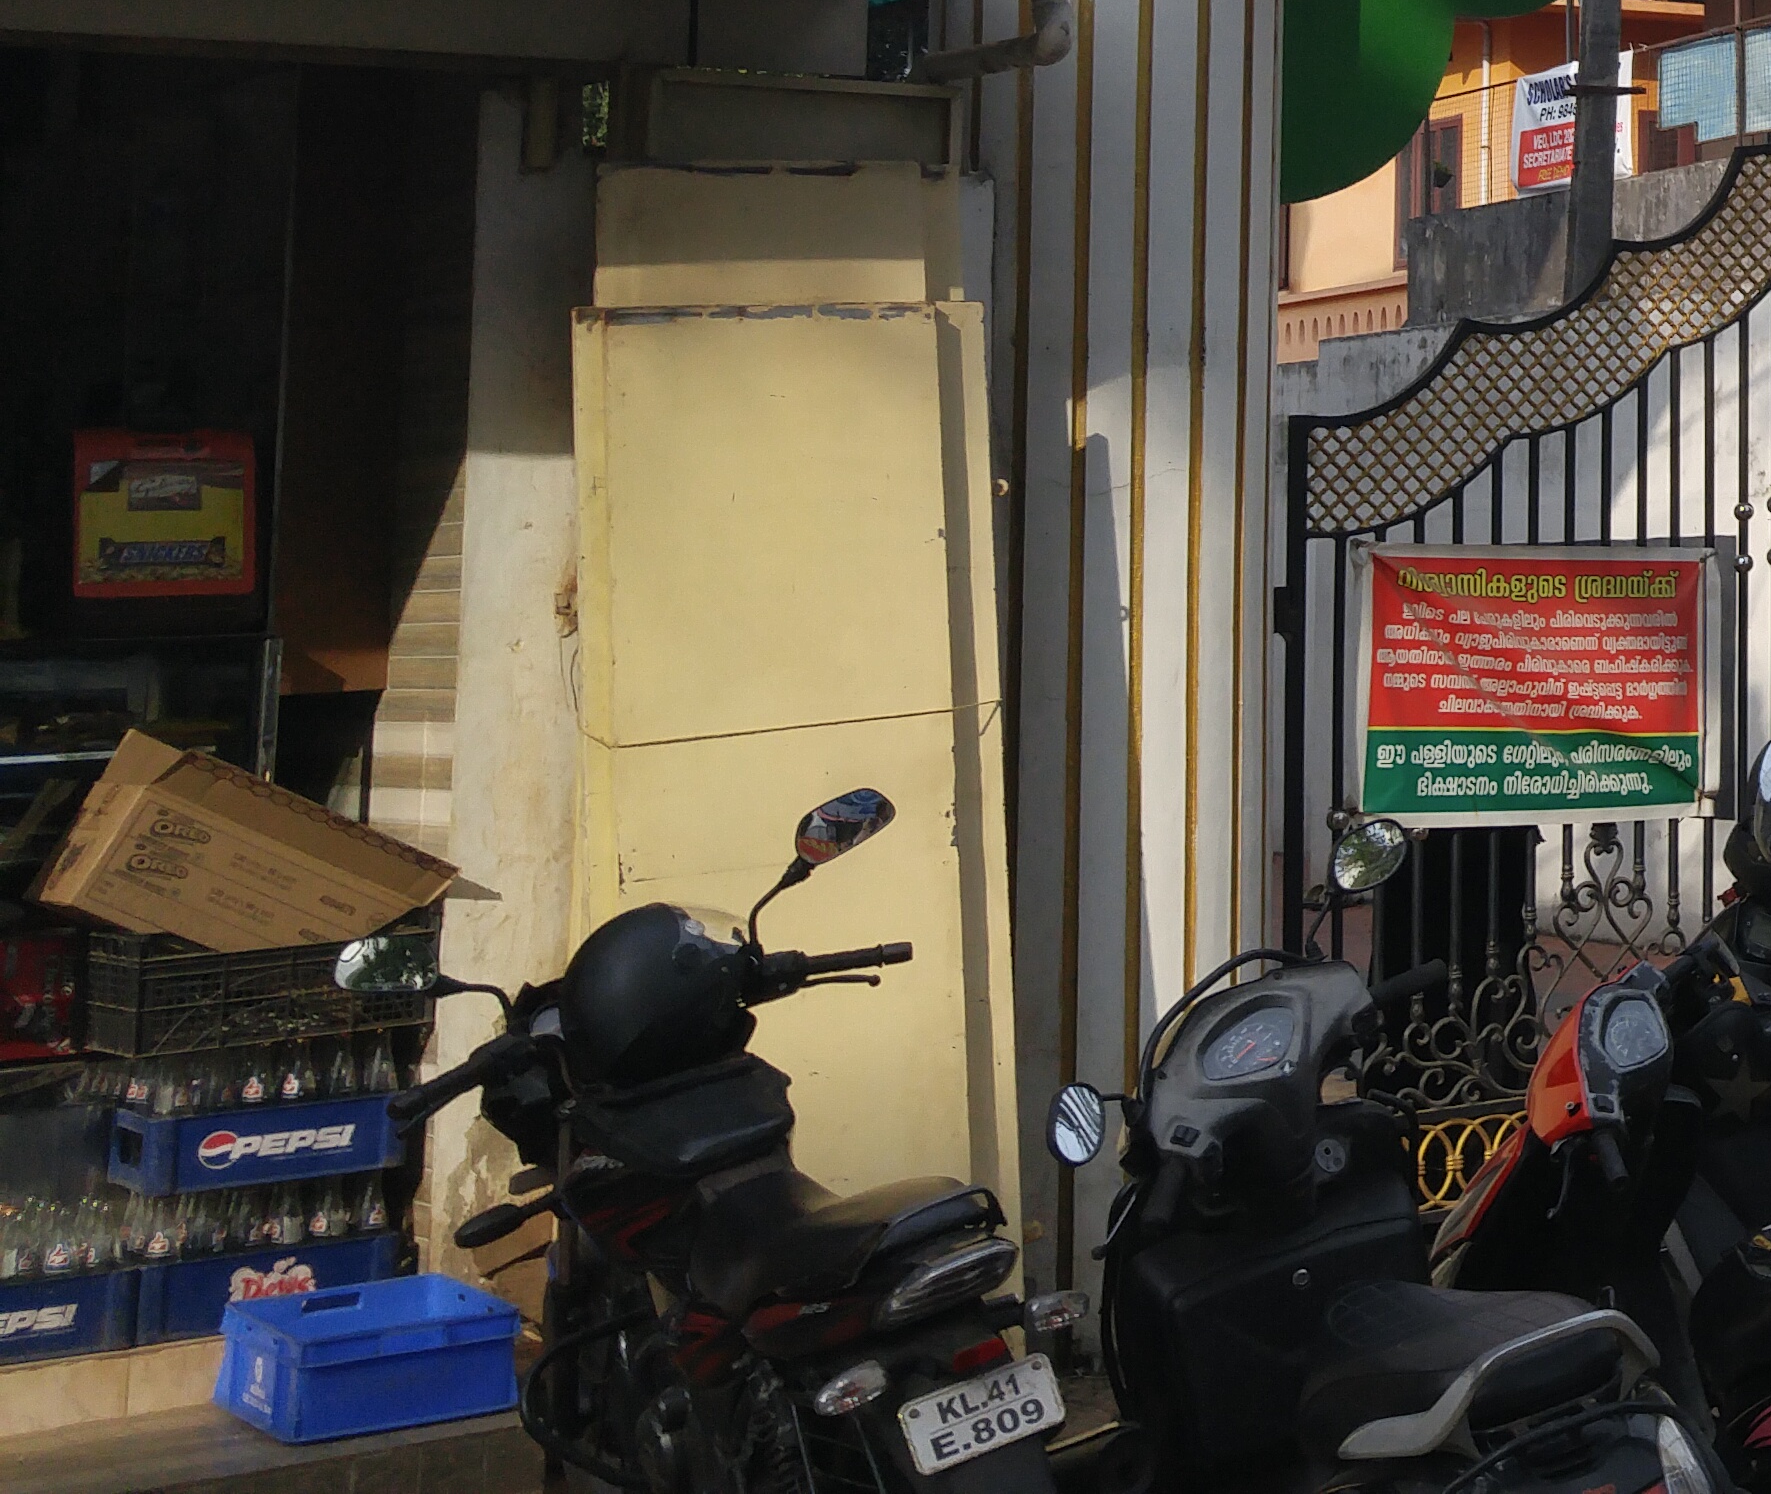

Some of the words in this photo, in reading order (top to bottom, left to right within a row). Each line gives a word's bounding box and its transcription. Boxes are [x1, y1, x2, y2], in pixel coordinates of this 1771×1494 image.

[1396, 566, 1568, 604] വിശ്വാസികളുടെ
[1573, 568, 1680, 604] ശ്രദ്ധയ്ക്ക്
[1448, 609, 1471, 624] പല
[1457, 652, 1513, 671] ഇത്തരം
[1376, 743, 1407, 769] ഈ
[1410, 740, 1498, 769] പള്ളിയുടെ
[1416, 771, 1498, 797] ഭിക്ഷാടനം
[1503, 770, 1655, 800] നിരോധിച്ചിരിക്കുന്നു.
[152, 818, 209, 844] OREO
[127, 853, 188, 880] OREO
[229, 1123, 356, 1161] PEPSI
[935, 1372, 1022, 1424] KL.41
[929, 1397, 1045, 1463] E.809
